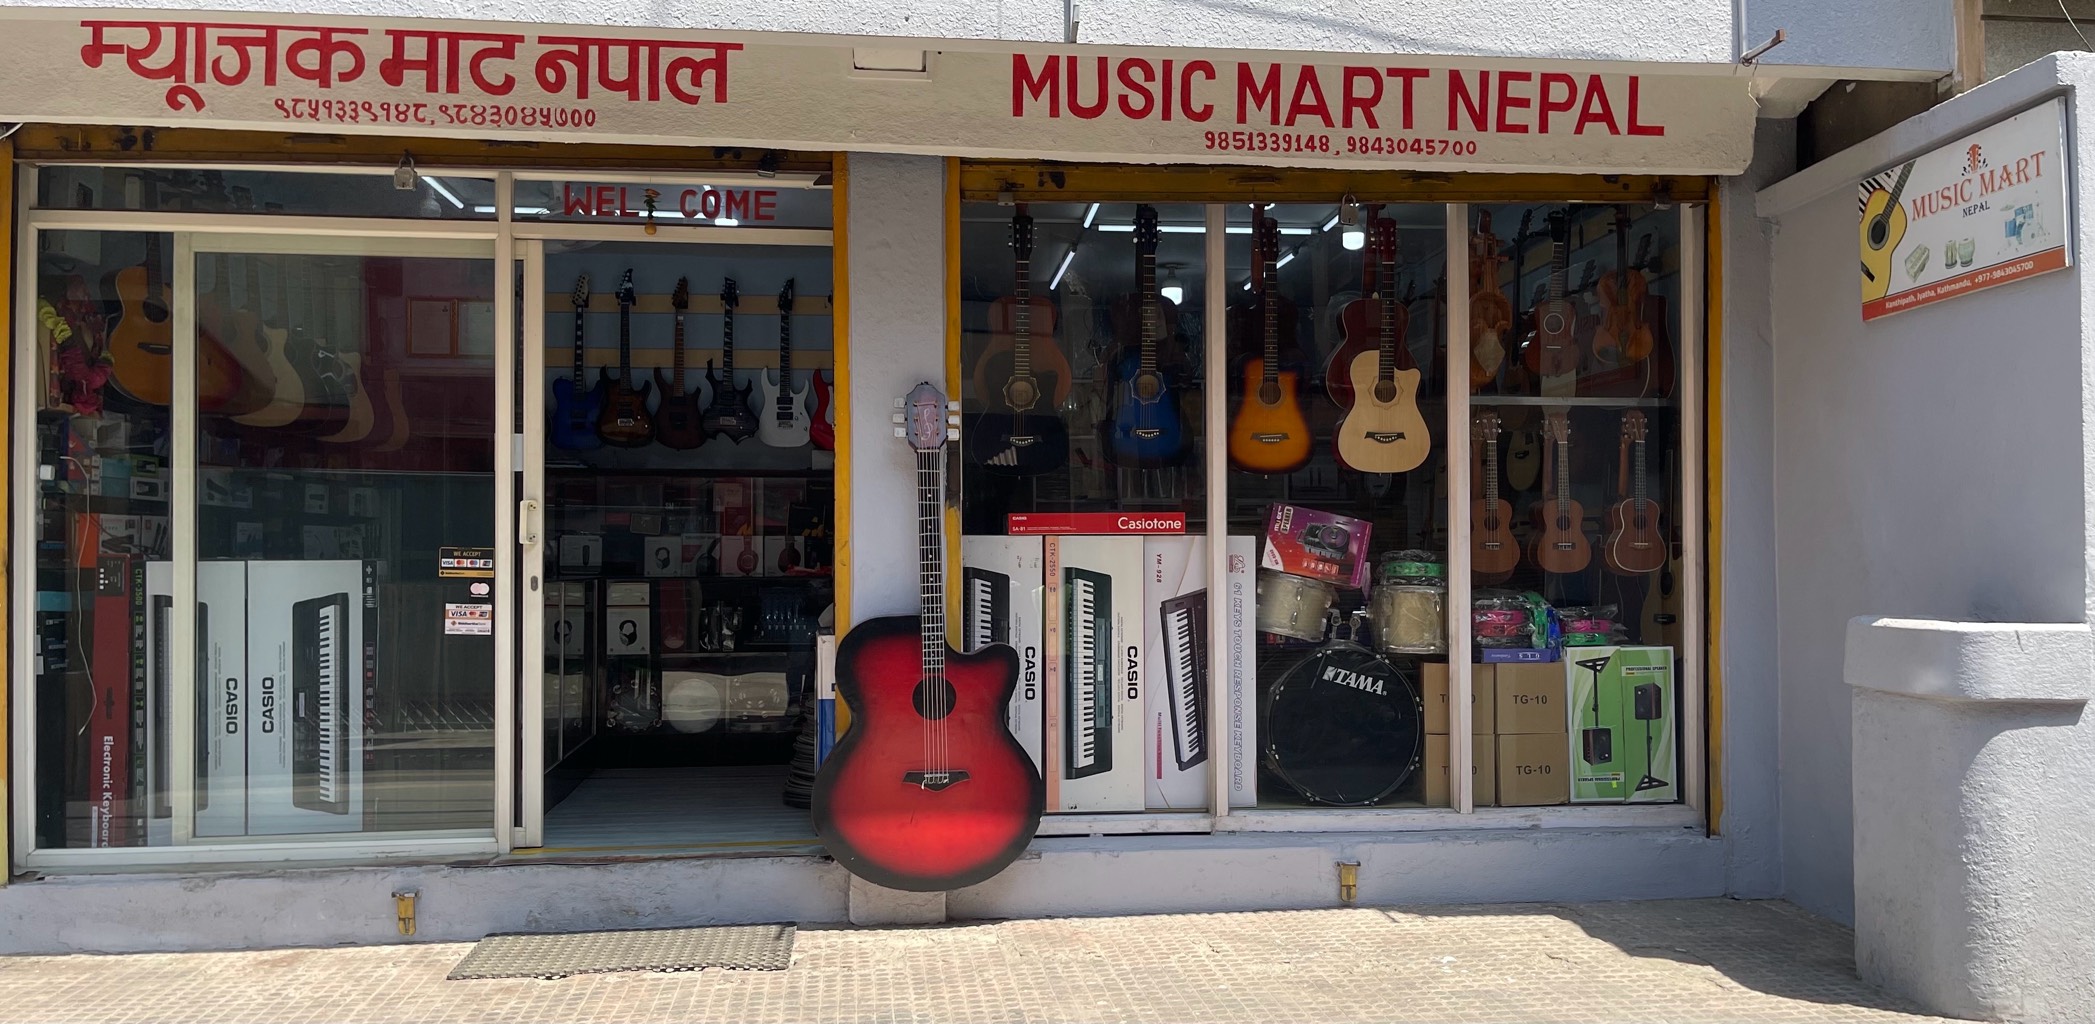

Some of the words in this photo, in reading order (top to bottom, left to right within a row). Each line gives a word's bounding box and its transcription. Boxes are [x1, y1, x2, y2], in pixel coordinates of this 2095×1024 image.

[1012, 53, 1214, 122] MUSIC
[1236, 62, 1430, 129] MART
[1448, 69, 1664, 136] NEPAL
[1346, 136, 1478, 156] 9843045700
[564, 182, 639, 217] WEL
[680, 189, 777, 221] COME
[1911, 178, 1972, 222] MUSIC
[1979, 151, 2046, 197] MART
[1962, 200, 1991, 218] NEPAL
[1118, 516, 1182, 529] Casiotone
[135, 569, 143, 605] CTK-3500
[1233, 583, 1242, 595] 61
[1233, 598, 1242, 627] KEYS
[1233, 630, 1242, 668] TOUCH
[1025, 646, 1036, 700] CASIO
[1127, 646, 1138, 700] CASIO
[1333, 668, 1384, 695] TAMA
[226, 678, 237, 734] CASIO
[262, 677, 274, 733] CASIO
[1233, 670, 1242, 729] RESPONSE
[1513, 694, 1548, 705] TG-10
[103, 735, 114, 788] Electronic
[1233, 731, 1242, 791] KEYBOARD
[1515, 764, 1551, 776] TG-10
